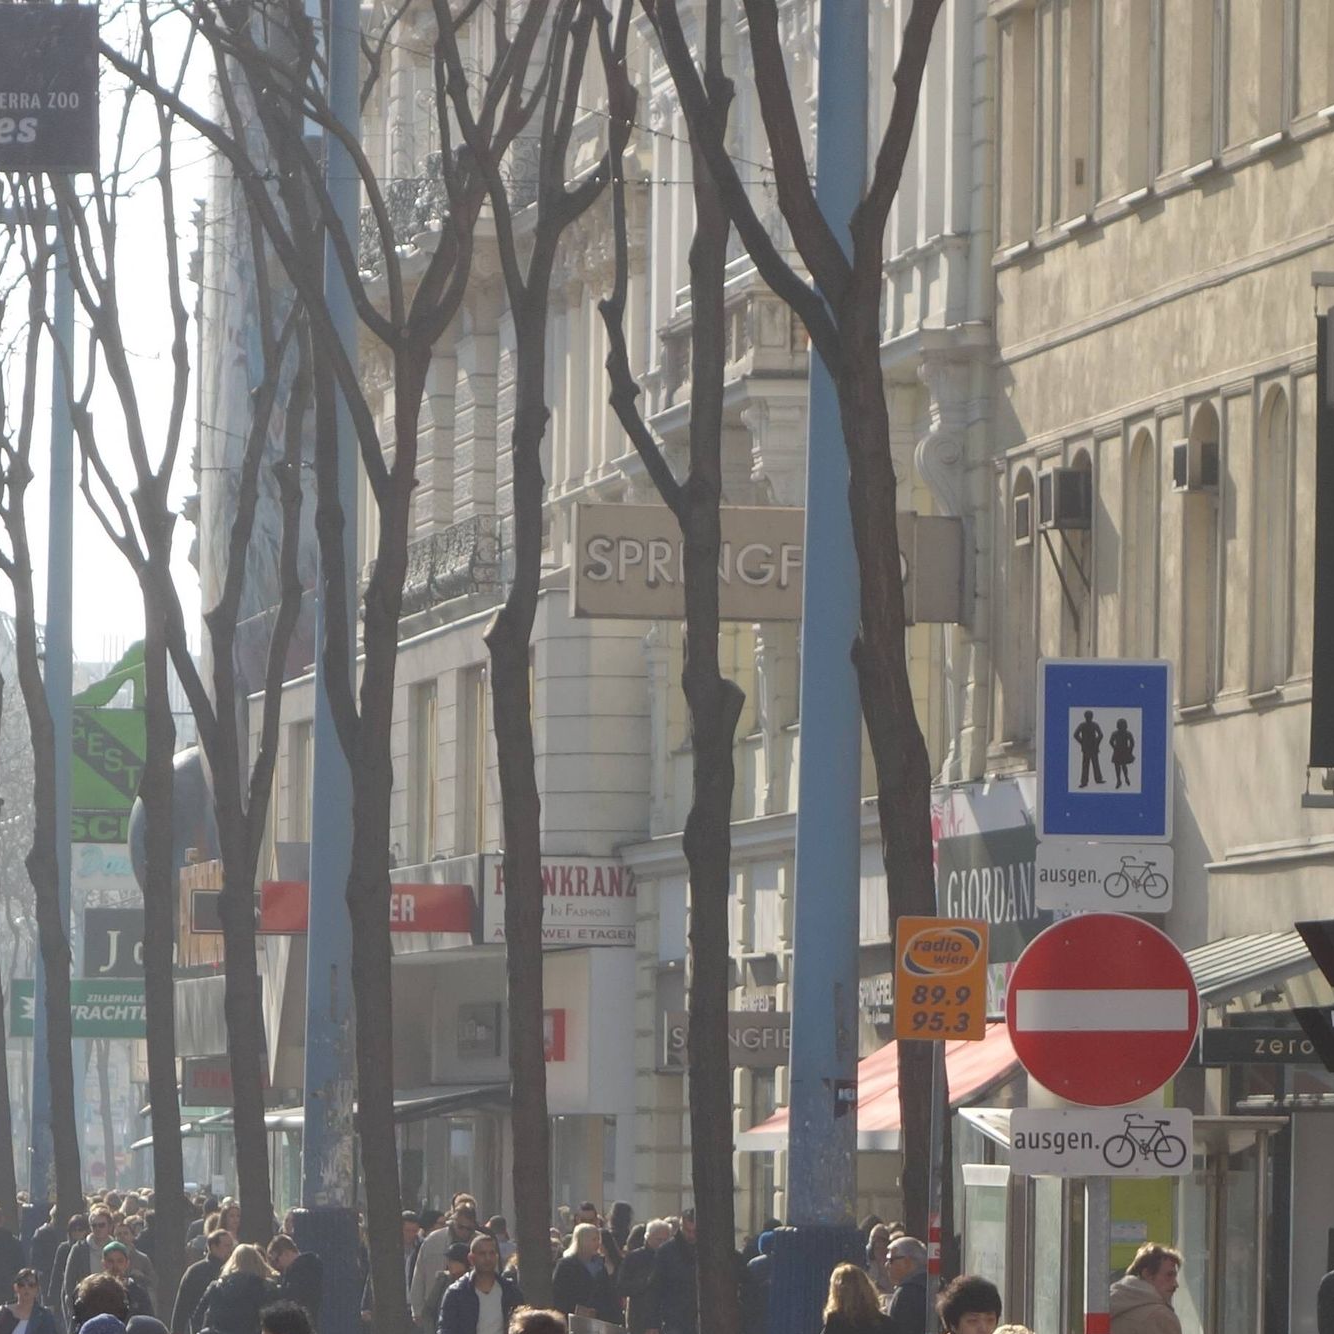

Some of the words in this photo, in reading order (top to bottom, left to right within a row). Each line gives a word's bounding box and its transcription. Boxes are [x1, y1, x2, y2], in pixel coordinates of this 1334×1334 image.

[47, 92, 80, 110] ZOO
[1039, 865, 1102, 888] ausgen.
[947, 862, 1039, 925] GIORDAN
[914, 938, 963, 953] radio
[933, 954, 972, 966] wien
[911, 985, 971, 1006] 89.9
[911, 1011, 971, 1032] 95.3
[1254, 1039, 1315, 1055] zero
[1014, 1127, 1101, 1154] ausgen.
